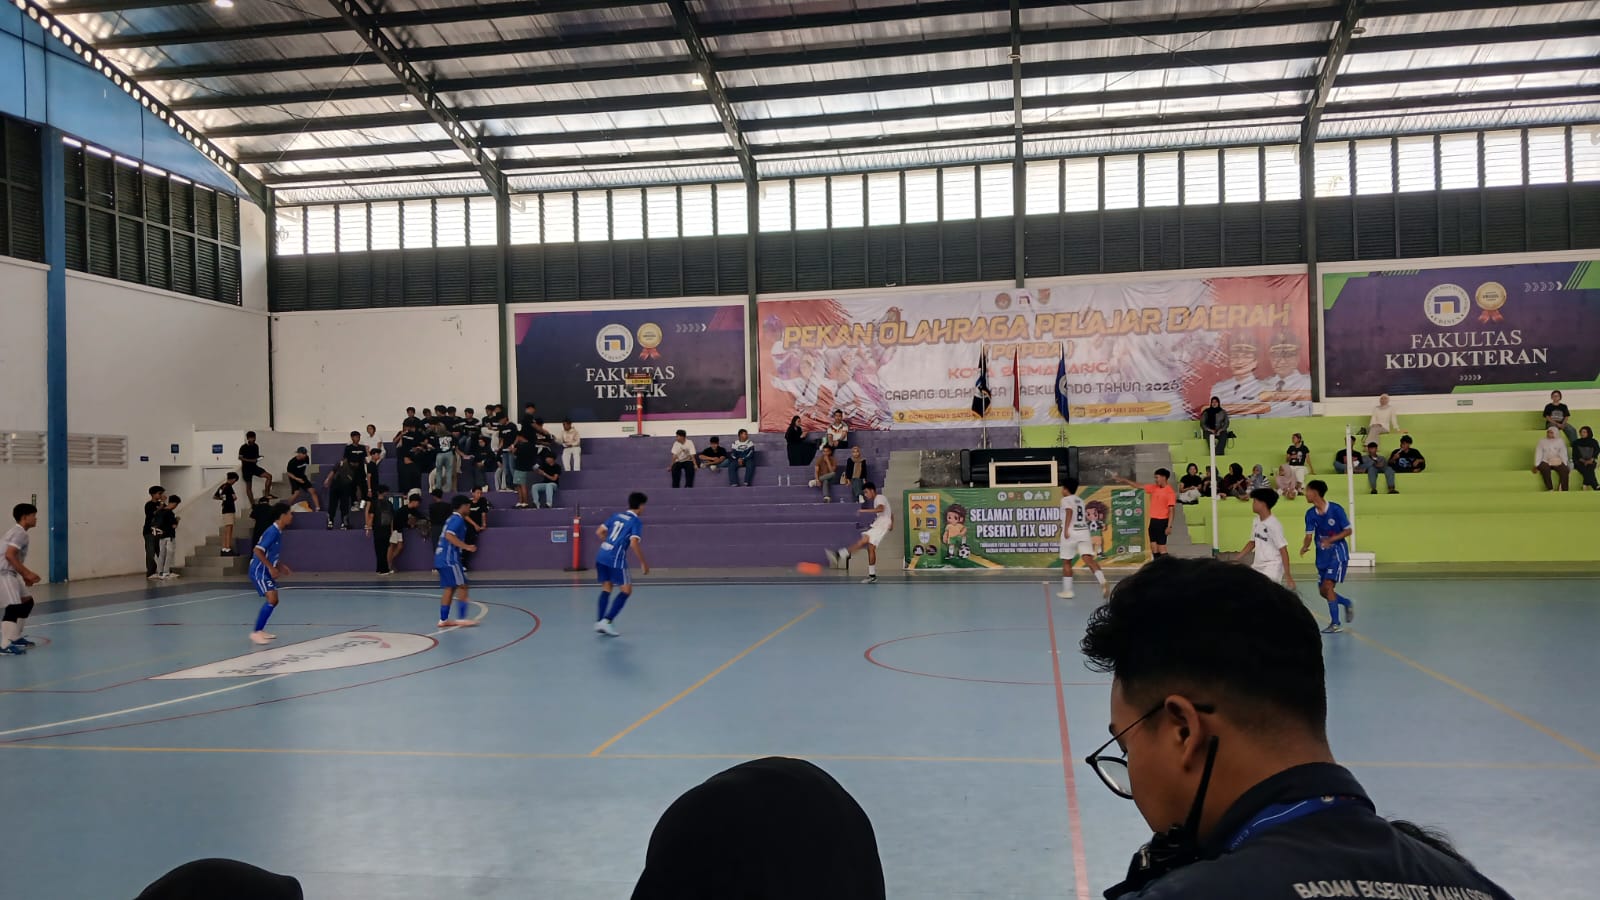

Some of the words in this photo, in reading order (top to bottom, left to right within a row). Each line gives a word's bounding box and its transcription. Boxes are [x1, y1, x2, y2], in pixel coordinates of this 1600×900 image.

[783, 322, 874, 349] PEKAN
[878, 314, 1030, 347] OLAHRAGA
[1034, 306, 1162, 339] PELAJAR
[1166, 303, 1291, 334] DAERAH
[1410, 329, 1522, 349] FAKULTAS
[1385, 347, 1548, 369] KEDOKTERAN
[1001, 362, 1110, 377] SEMAANG
[594, 383, 668, 399] TEKK
[884, 388, 935, 401] CABANG
[938, 386, 1007, 399] OLAHGA
[1017, 383, 1092, 396] AEKWNDO
[1095, 381, 1141, 393] TAHUN
[969, 507, 1014, 522] SELAMAT
[1076, 505, 1083, 522] 8
[609, 521, 624, 541] 11
[976, 524, 1018, 538] PESERTA
[1020, 523, 1036, 538] FIX
[1038, 523, 1058, 538] CUP
[1293, 879, 1359, 899] BADAN
[1355, 880, 1430, 900] EKSEKUTIF
